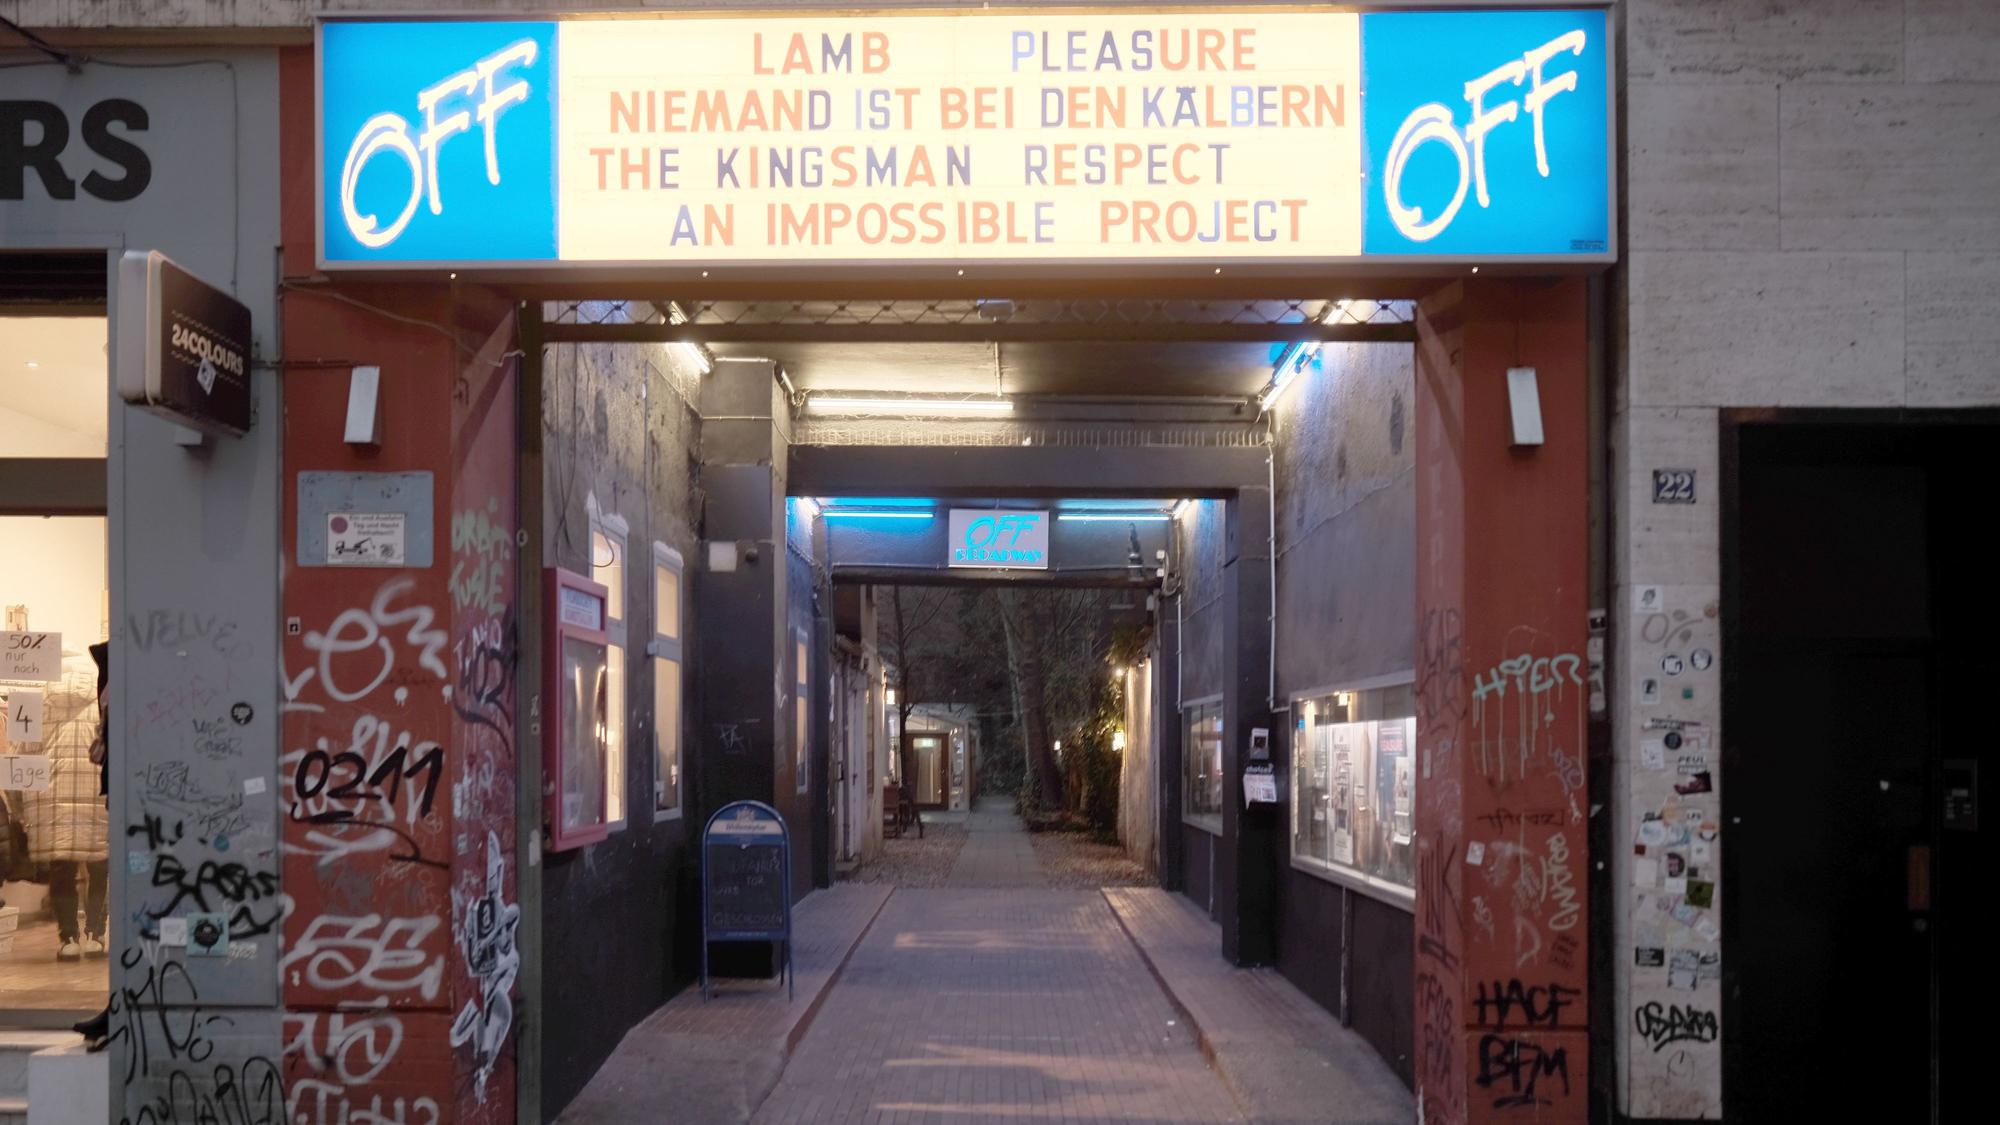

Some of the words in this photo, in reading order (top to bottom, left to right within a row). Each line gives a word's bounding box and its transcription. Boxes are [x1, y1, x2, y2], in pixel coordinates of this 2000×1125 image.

[754, 32, 891, 75] LAMB
[1012, 28, 1256, 72] PLEASURE
[609, 89, 831, 133] NIEMAND
[855, 87, 921, 131] IST
[941, 86, 1014, 130] BEI
[1041, 85, 1126, 129] DEN
[0, 98, 152, 202] RS
[341, 39, 538, 248] OFF
[1383, 28, 1586, 241] OFF
[590, 146, 679, 190] THE
[718, 145, 970, 189] KINGSMAN
[1024, 142, 1231, 186] RESPECT
[670, 202, 734, 247] AN
[767, 200, 1055, 246] IMPOSSIBLE
[1101, 198, 1308, 243] PROJECT
[172, 323, 244, 376] 24COLOURS
[1659, 471, 1692, 499] 22
[965, 514, 1040, 549] OFF
[5, 650, 26, 662] nur
[8, 634, 48, 650] 50%
[14, 662, 40, 674] noch
[15, 704, 33, 733] 4
[3, 756, 46, 788] Tage
